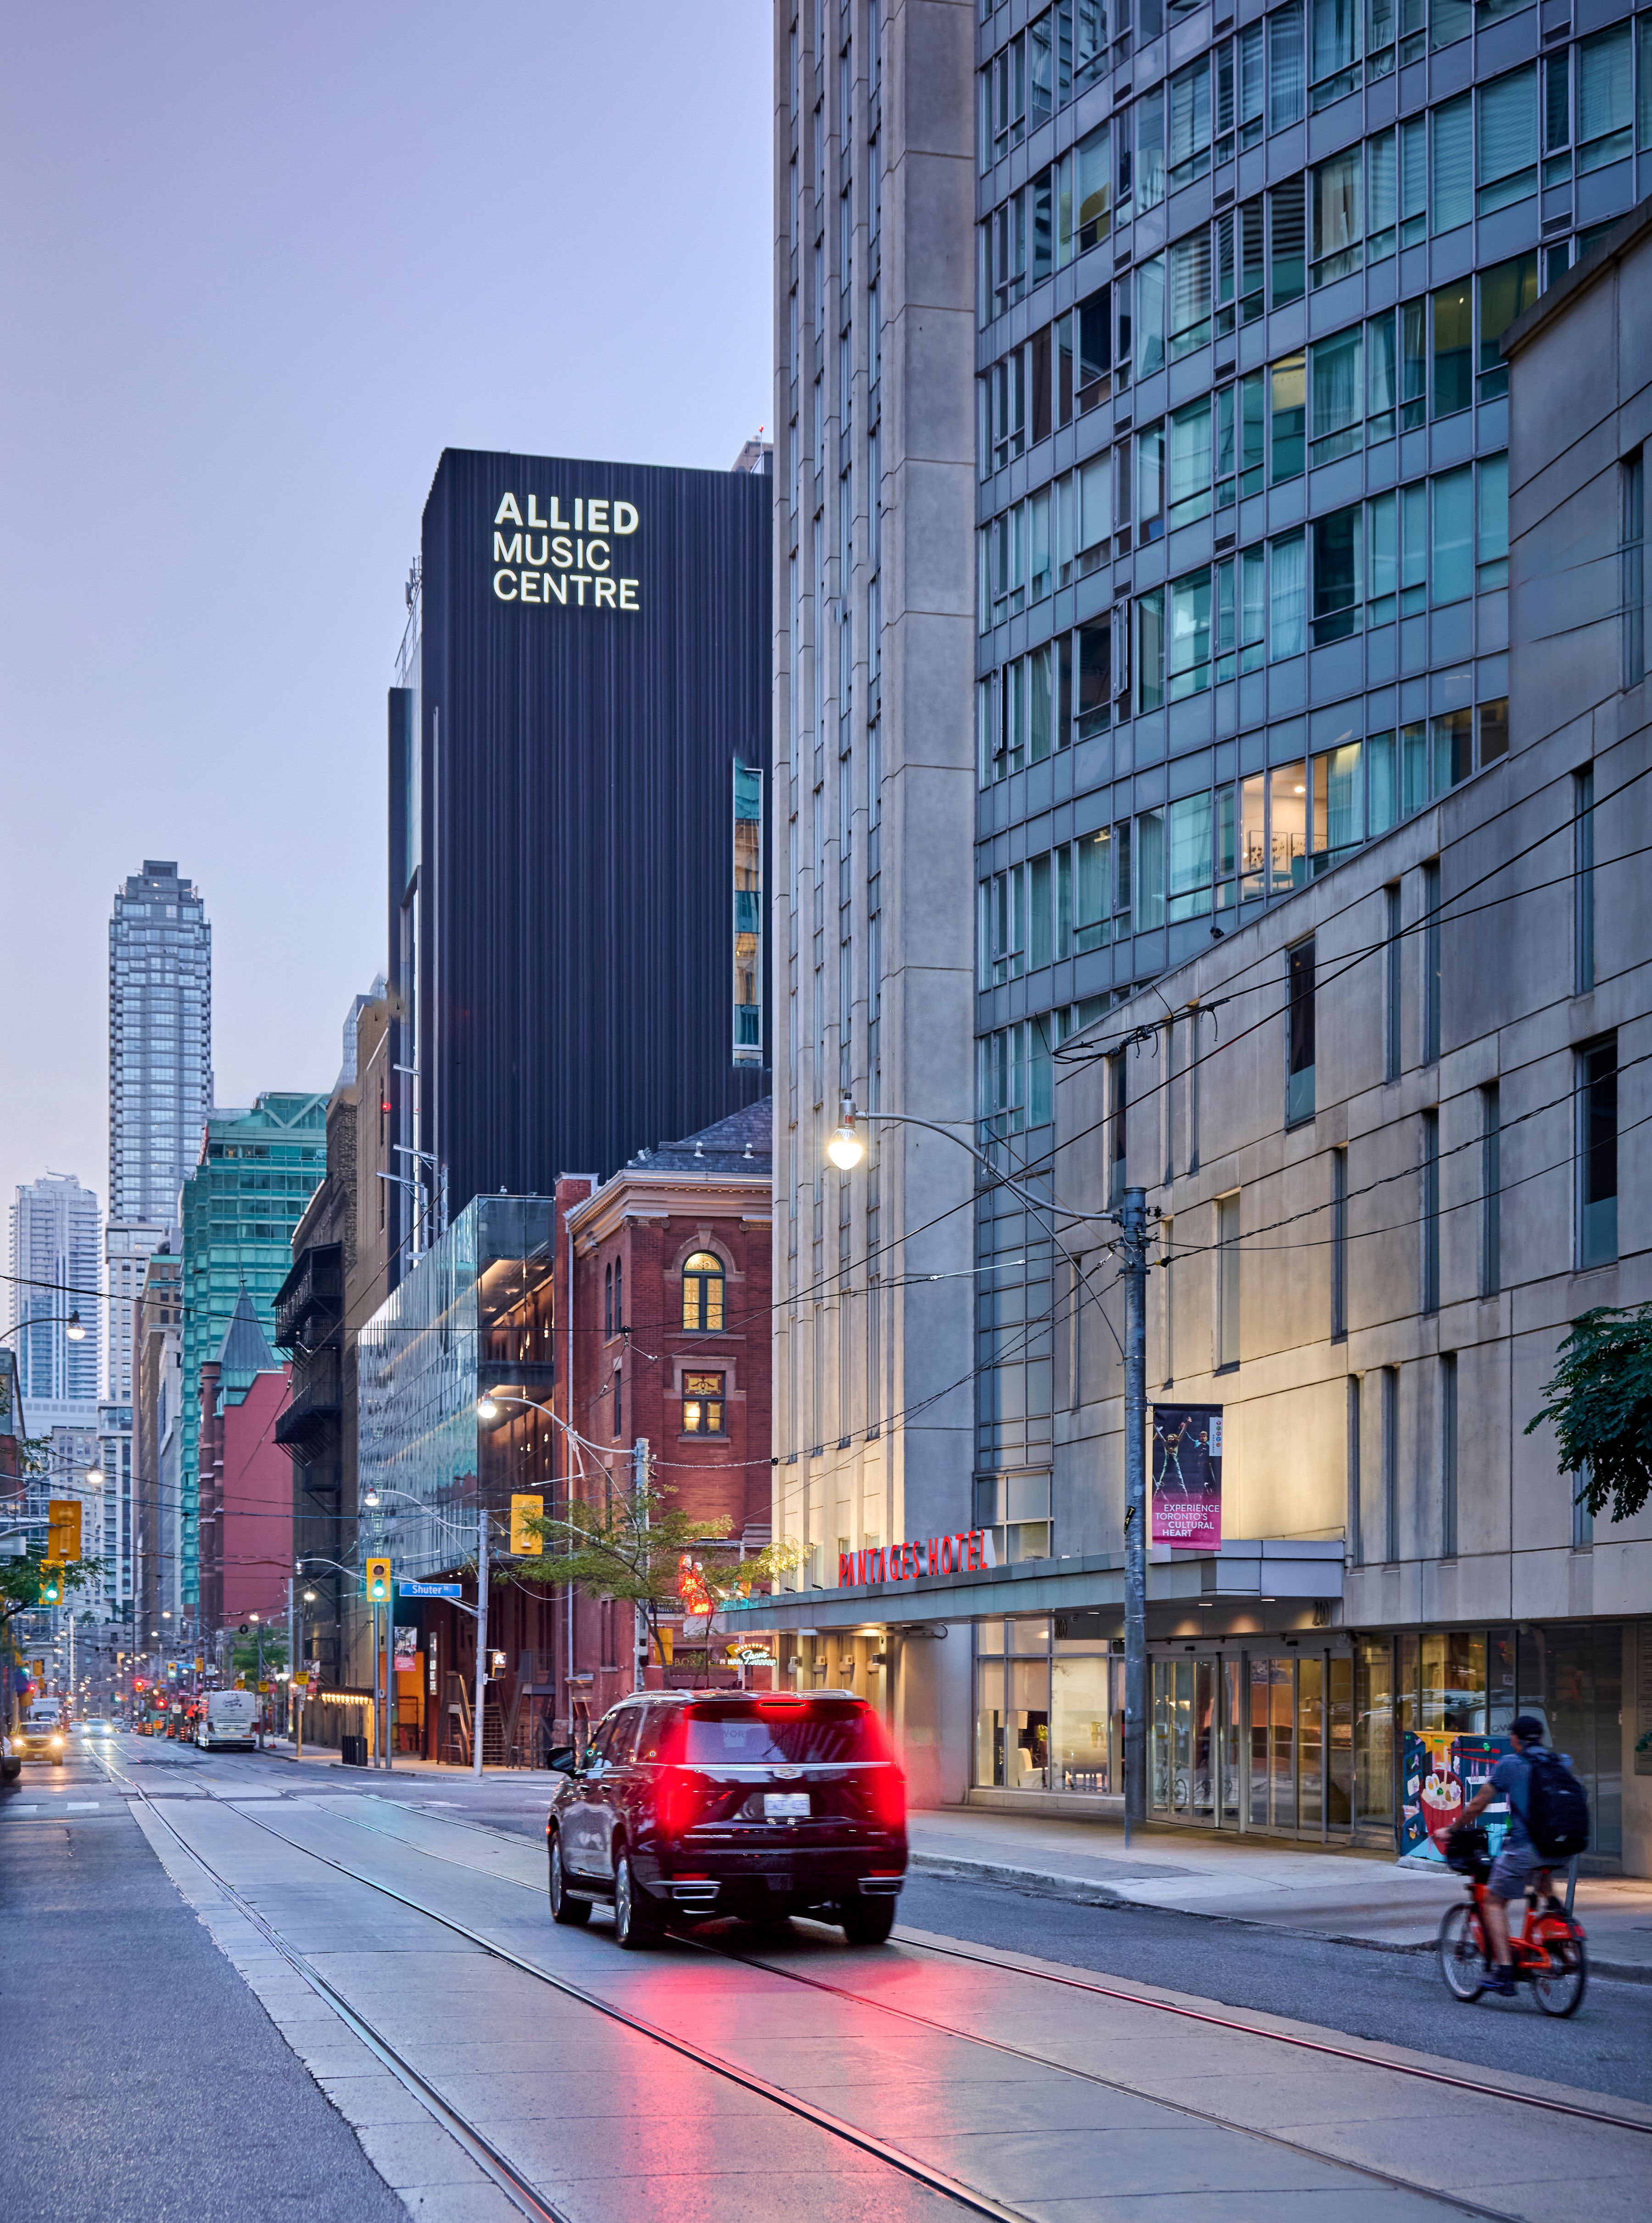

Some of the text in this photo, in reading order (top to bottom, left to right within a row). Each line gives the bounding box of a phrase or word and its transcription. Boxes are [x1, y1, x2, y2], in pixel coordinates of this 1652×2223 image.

[494, 492, 639, 535] ALLIED
[493, 531, 610, 571] MUSIC
[493, 569, 640, 610] CENTRE
[1168, 1521, 1214, 1529] CULTURAL
[839, 1529, 987, 1588] PANTAGES HOTEL
[412, 1585, 442, 1594] Shuter
[1055, 1620, 1067, 1638] 200
